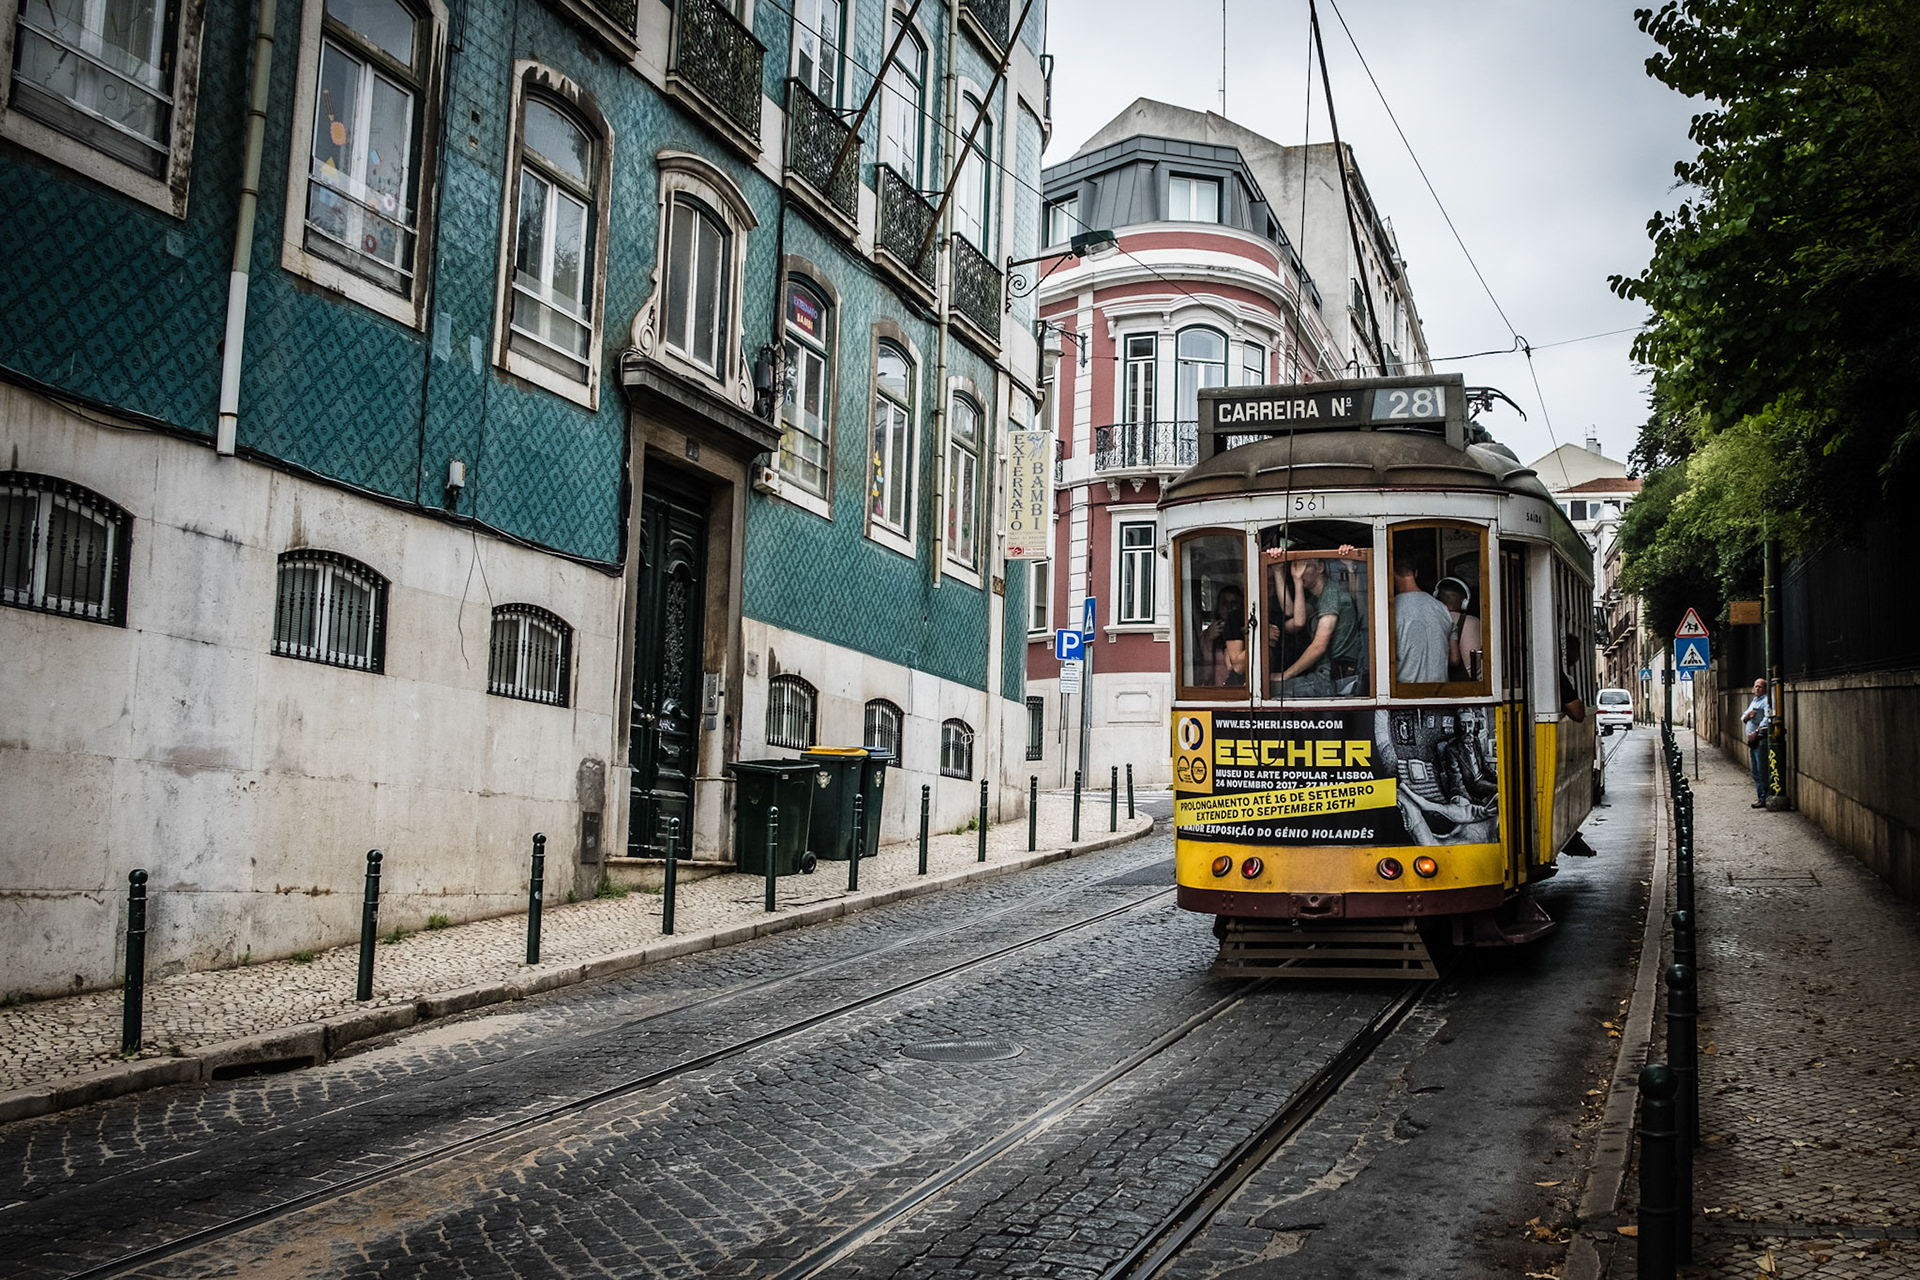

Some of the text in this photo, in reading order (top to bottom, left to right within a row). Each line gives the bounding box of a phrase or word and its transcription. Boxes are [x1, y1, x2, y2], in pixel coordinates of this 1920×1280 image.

[1219, 399, 1319, 423] CARREIRA
[1389, 389, 1434, 418] 28
[1010, 435, 1026, 531] EXTERNATO
[1031, 462, 1045, 530] BAMBI
[1295, 495, 1325, 511] 561
[1062, 632, 1080, 657] P
[1215, 719, 1343, 729] WWW.ESCHERLISBOA.COM
[1215, 739, 1371, 767] ESCHER
[1215, 769, 1241, 778] MUSEU
[1243, 770, 1255, 779] DE
[1257, 771, 1280, 779] ARTE
[1283, 771, 1327, 780] POPULAR
[1337, 771, 1374, 780] LISBOA
[1215, 779, 1225, 788] 24
[1227, 780, 1274, 789] NOVEMBRO
[1276, 781, 1297, 789] 2017
[1180, 785, 1374, 811] PROLONGAMENTO ATÉ 16 DE SETEMBRO
[1196, 799, 1356, 821] EXTENDED TO SEPTEMBER 16TH
[1184, 824, 1205, 833] MAIOR
[1206, 824, 1254, 838] EXPOSIÇÃO
[1257, 828, 1272, 837] DO
[1275, 827, 1308, 838] GÉNIO
[1312, 828, 1374, 839] HOLANDÊS
